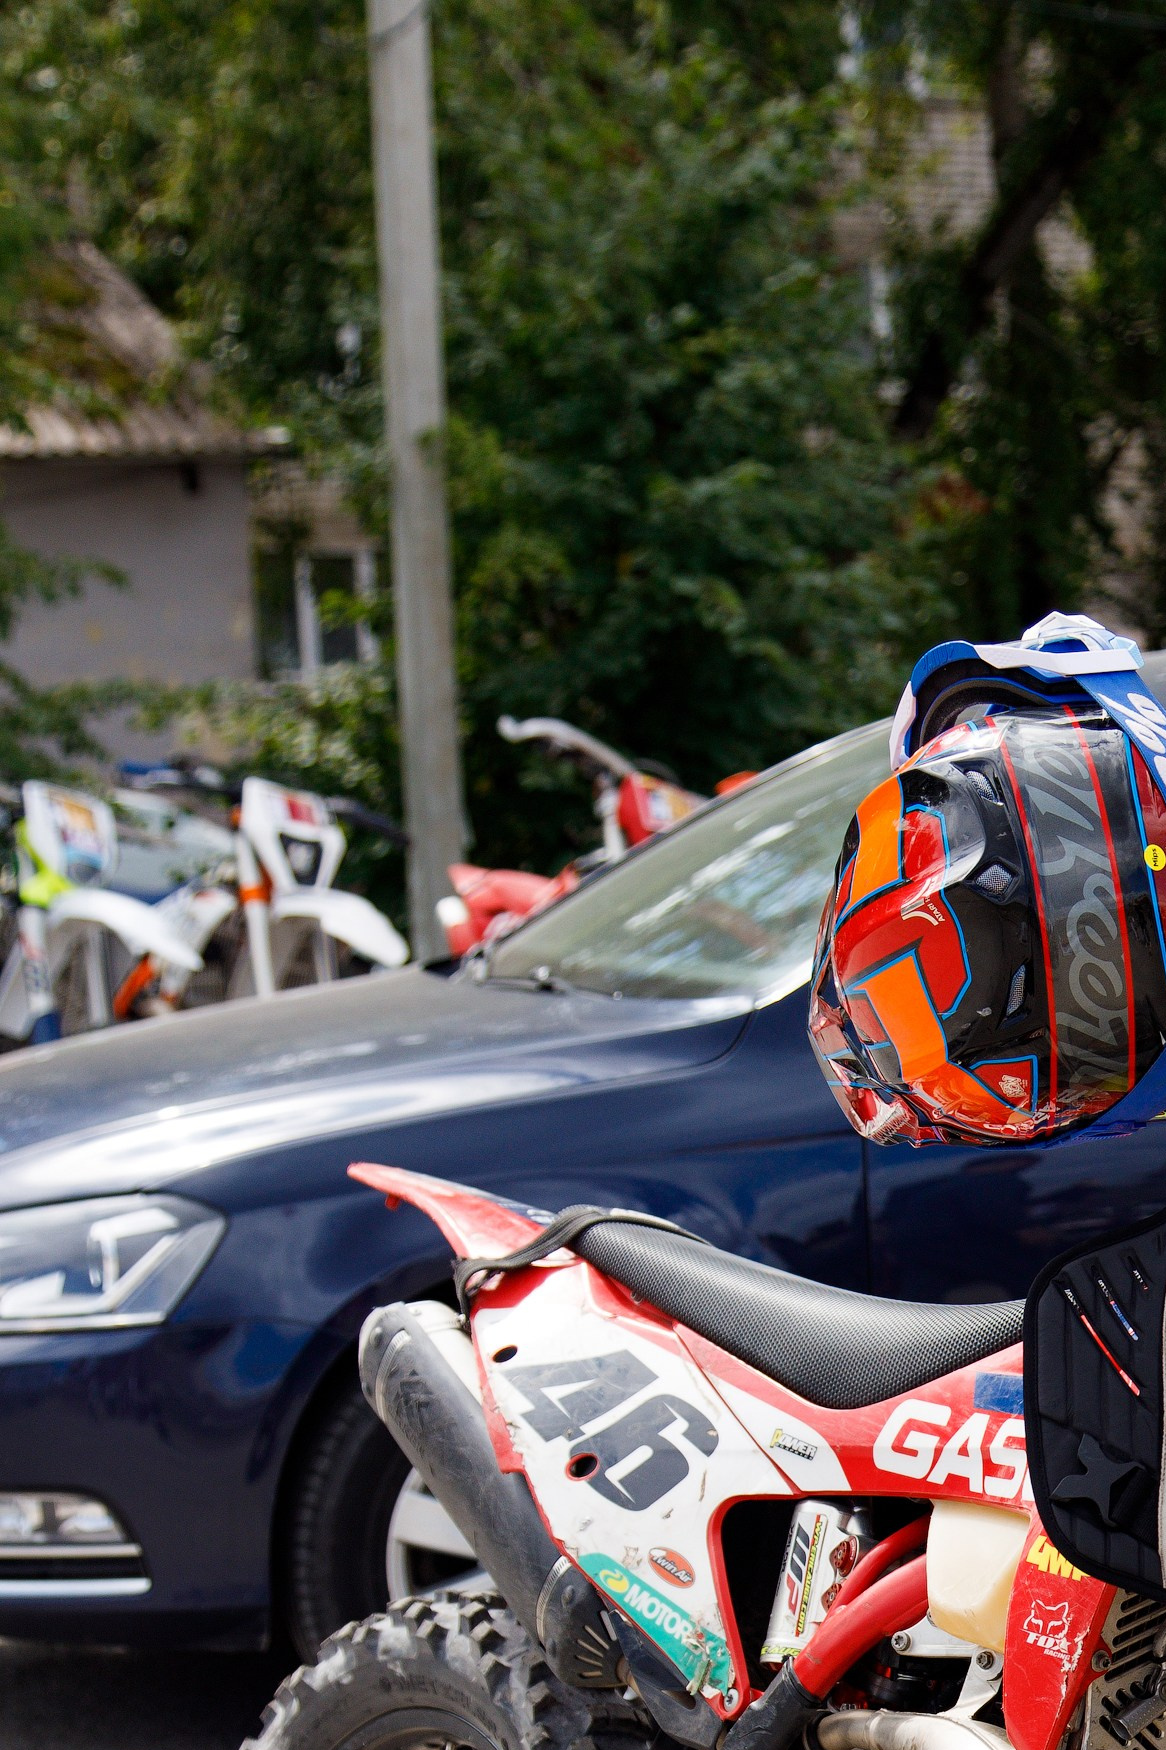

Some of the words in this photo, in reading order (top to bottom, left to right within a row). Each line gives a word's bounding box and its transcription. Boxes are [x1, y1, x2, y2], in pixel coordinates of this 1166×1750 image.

[1151, 847, 1160, 867] Mips
[500, 1350, 720, 1511] 46
[873, 1399, 1034, 1501] GAS
[675, 1568, 694, 1584] Air
[624, 1583, 694, 1643] MOTOR
[1025, 1631, 1071, 1653] FOX
[1043, 1649, 1071, 1660] RACING
